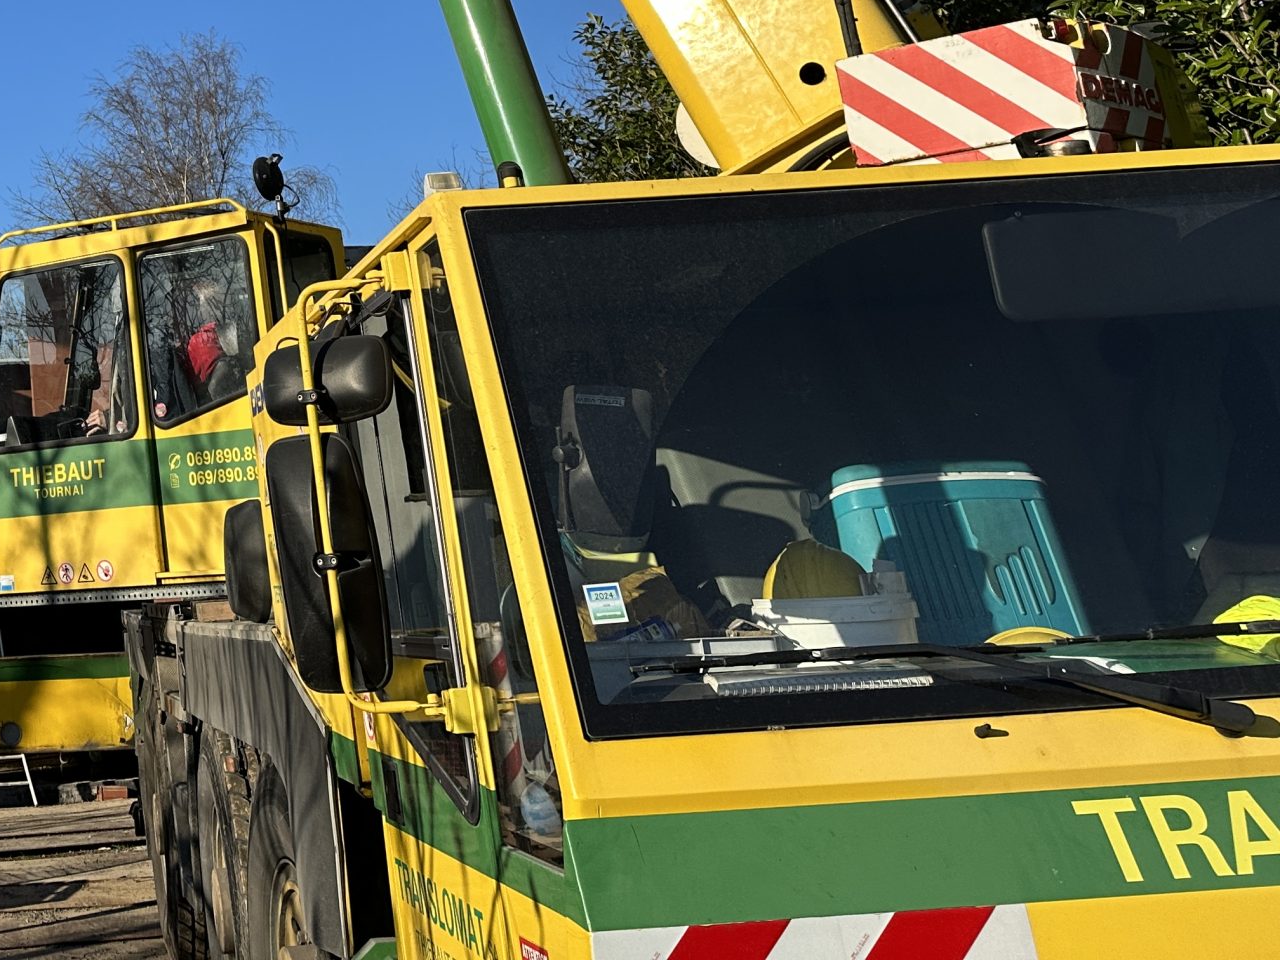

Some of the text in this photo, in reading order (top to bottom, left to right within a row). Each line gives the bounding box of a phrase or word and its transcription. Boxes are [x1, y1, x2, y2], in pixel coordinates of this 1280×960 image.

[10, 458, 105, 487] THIEBAUT
[33, 484, 84, 499] TOURNAI
[594, 591, 615, 601] 2024
[1071, 790, 1280, 882] TRA
[395, 857, 486, 958] TRANSLOMAT
